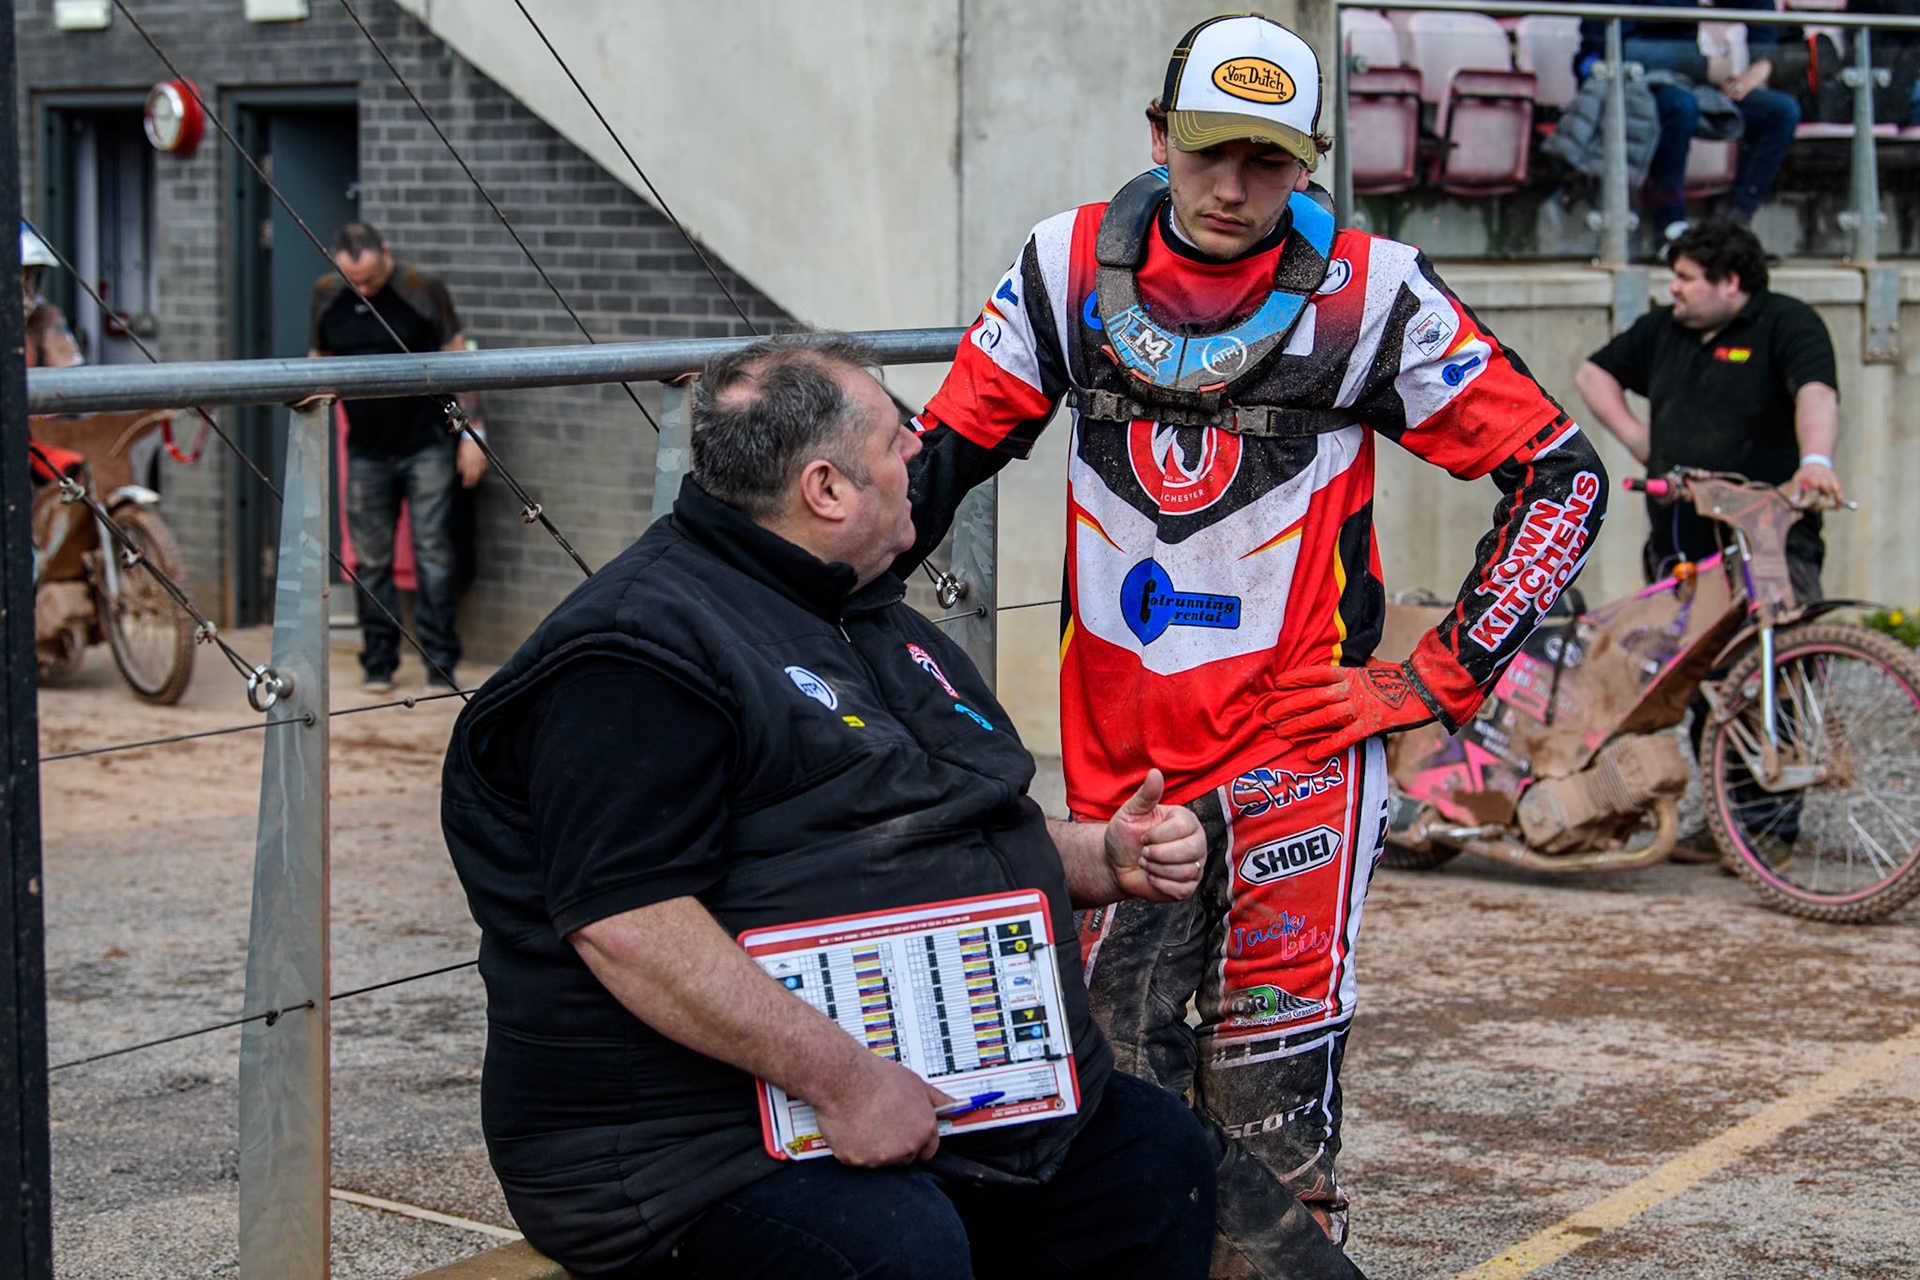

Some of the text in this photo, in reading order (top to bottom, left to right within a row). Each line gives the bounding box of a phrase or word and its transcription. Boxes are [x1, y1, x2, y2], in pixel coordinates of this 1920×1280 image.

[1225, 64, 1285, 94] Von Dutch
[1471, 474, 1598, 649] KITCHENS
[1476, 499, 1562, 596] TOWN
[1174, 610, 1222, 623] rental
[1252, 832, 1331, 879] SHOEI
[1232, 910, 1305, 957] Jack
[1281, 925, 1334, 960] Lily
[1223, 1098, 1318, 1140] SCOTT
